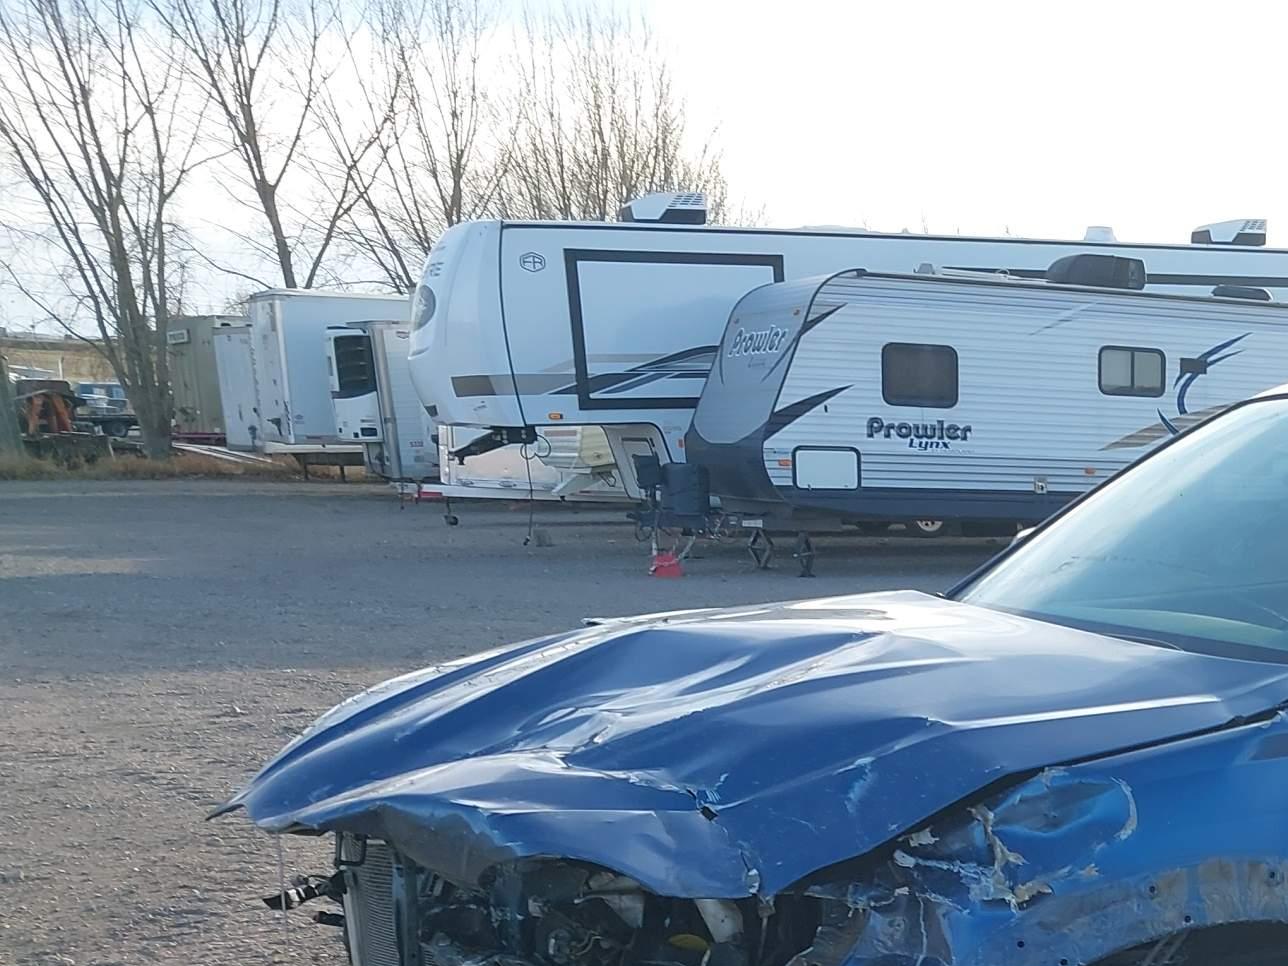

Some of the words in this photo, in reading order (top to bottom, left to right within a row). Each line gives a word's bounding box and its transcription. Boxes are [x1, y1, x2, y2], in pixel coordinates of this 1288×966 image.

[727, 324, 788, 357] Prowler
[866, 416, 972, 441] Prowler
[908, 438, 951, 451] Lynx
